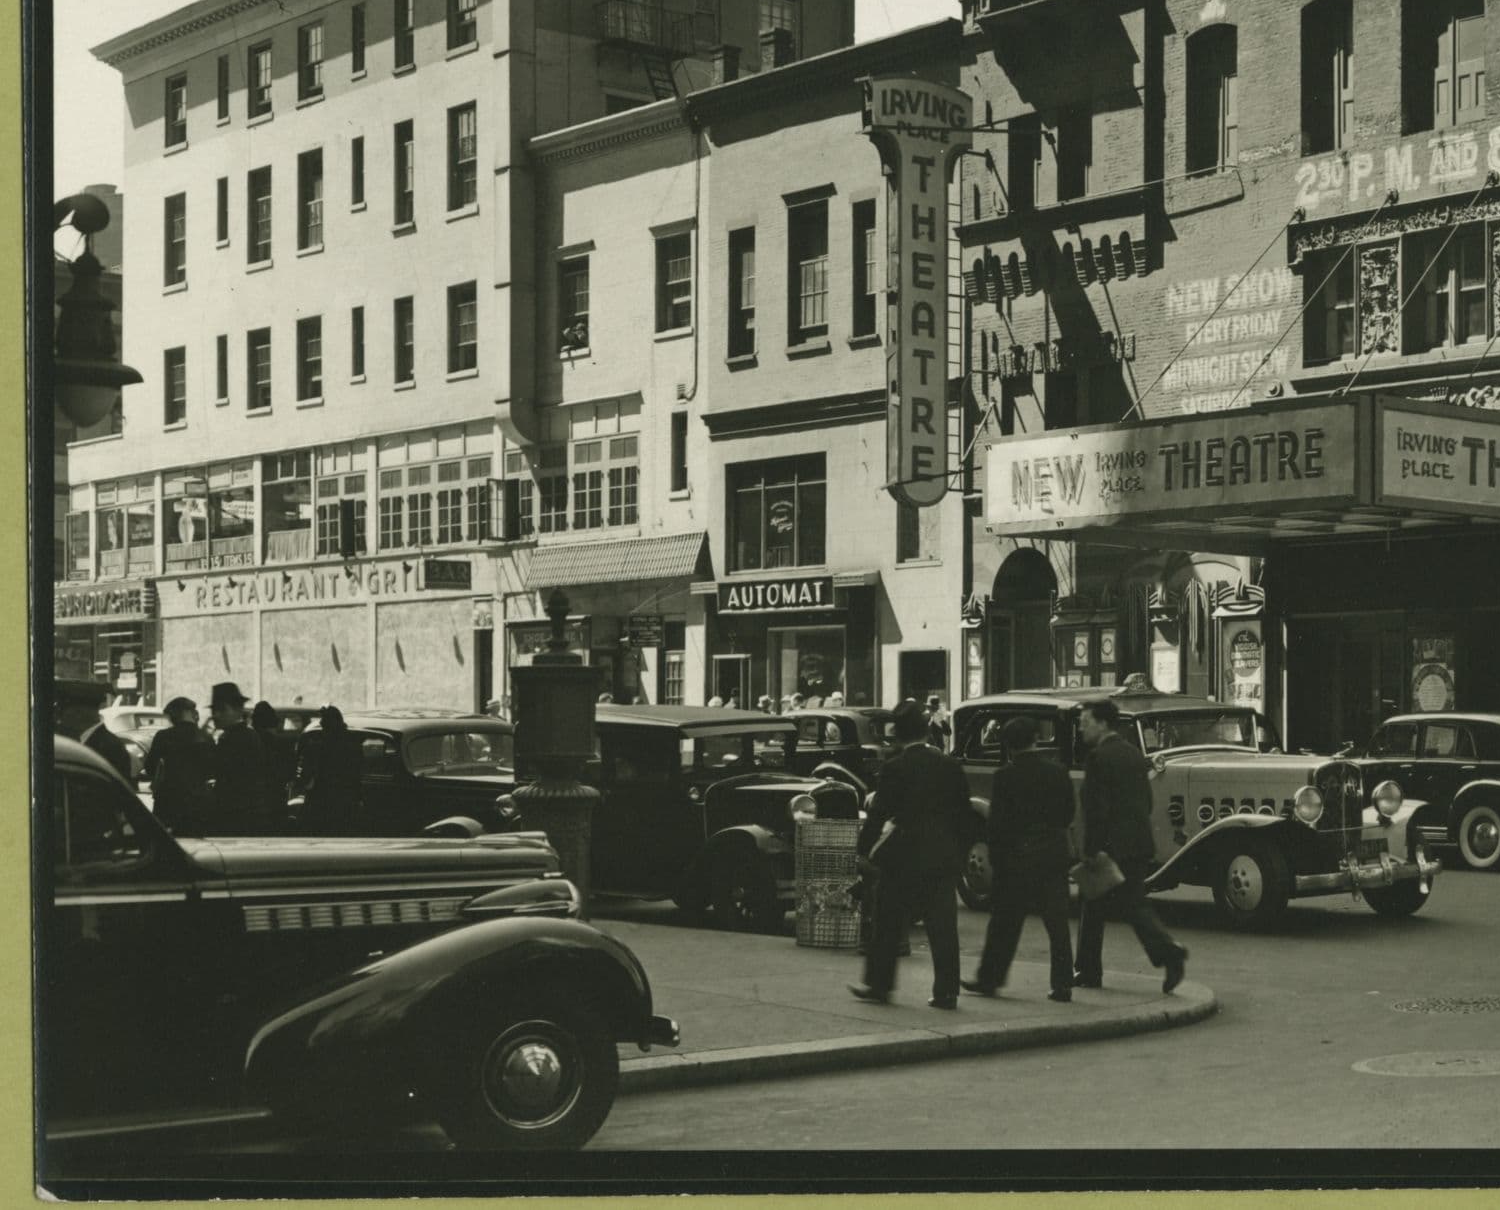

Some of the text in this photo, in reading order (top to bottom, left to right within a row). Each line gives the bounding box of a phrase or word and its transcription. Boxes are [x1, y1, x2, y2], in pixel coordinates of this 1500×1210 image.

[882, 88, 967, 128] IRVING
[897, 120, 951, 145] PLACE
[1429, 132, 1478, 184] AND
[1167, 268, 1292, 317] NEW SHOW
[911, 155, 937, 480] THEATRE
[1186, 309, 1283, 345] EVERY FRIDAY
[1163, 345, 1290, 390] MIDNIGHT SHOW
[1397, 427, 1458, 456] IRVING
[1012, 426, 1326, 512] NEW THEATRE
[1095, 450, 1147, 473] IRVING
[1402, 458, 1455, 480] PLACE
[429, 561, 465, 581] BAR
[196, 573, 339, 609] RESTAURANT
[727, 581, 825, 608] AUTOMAT
